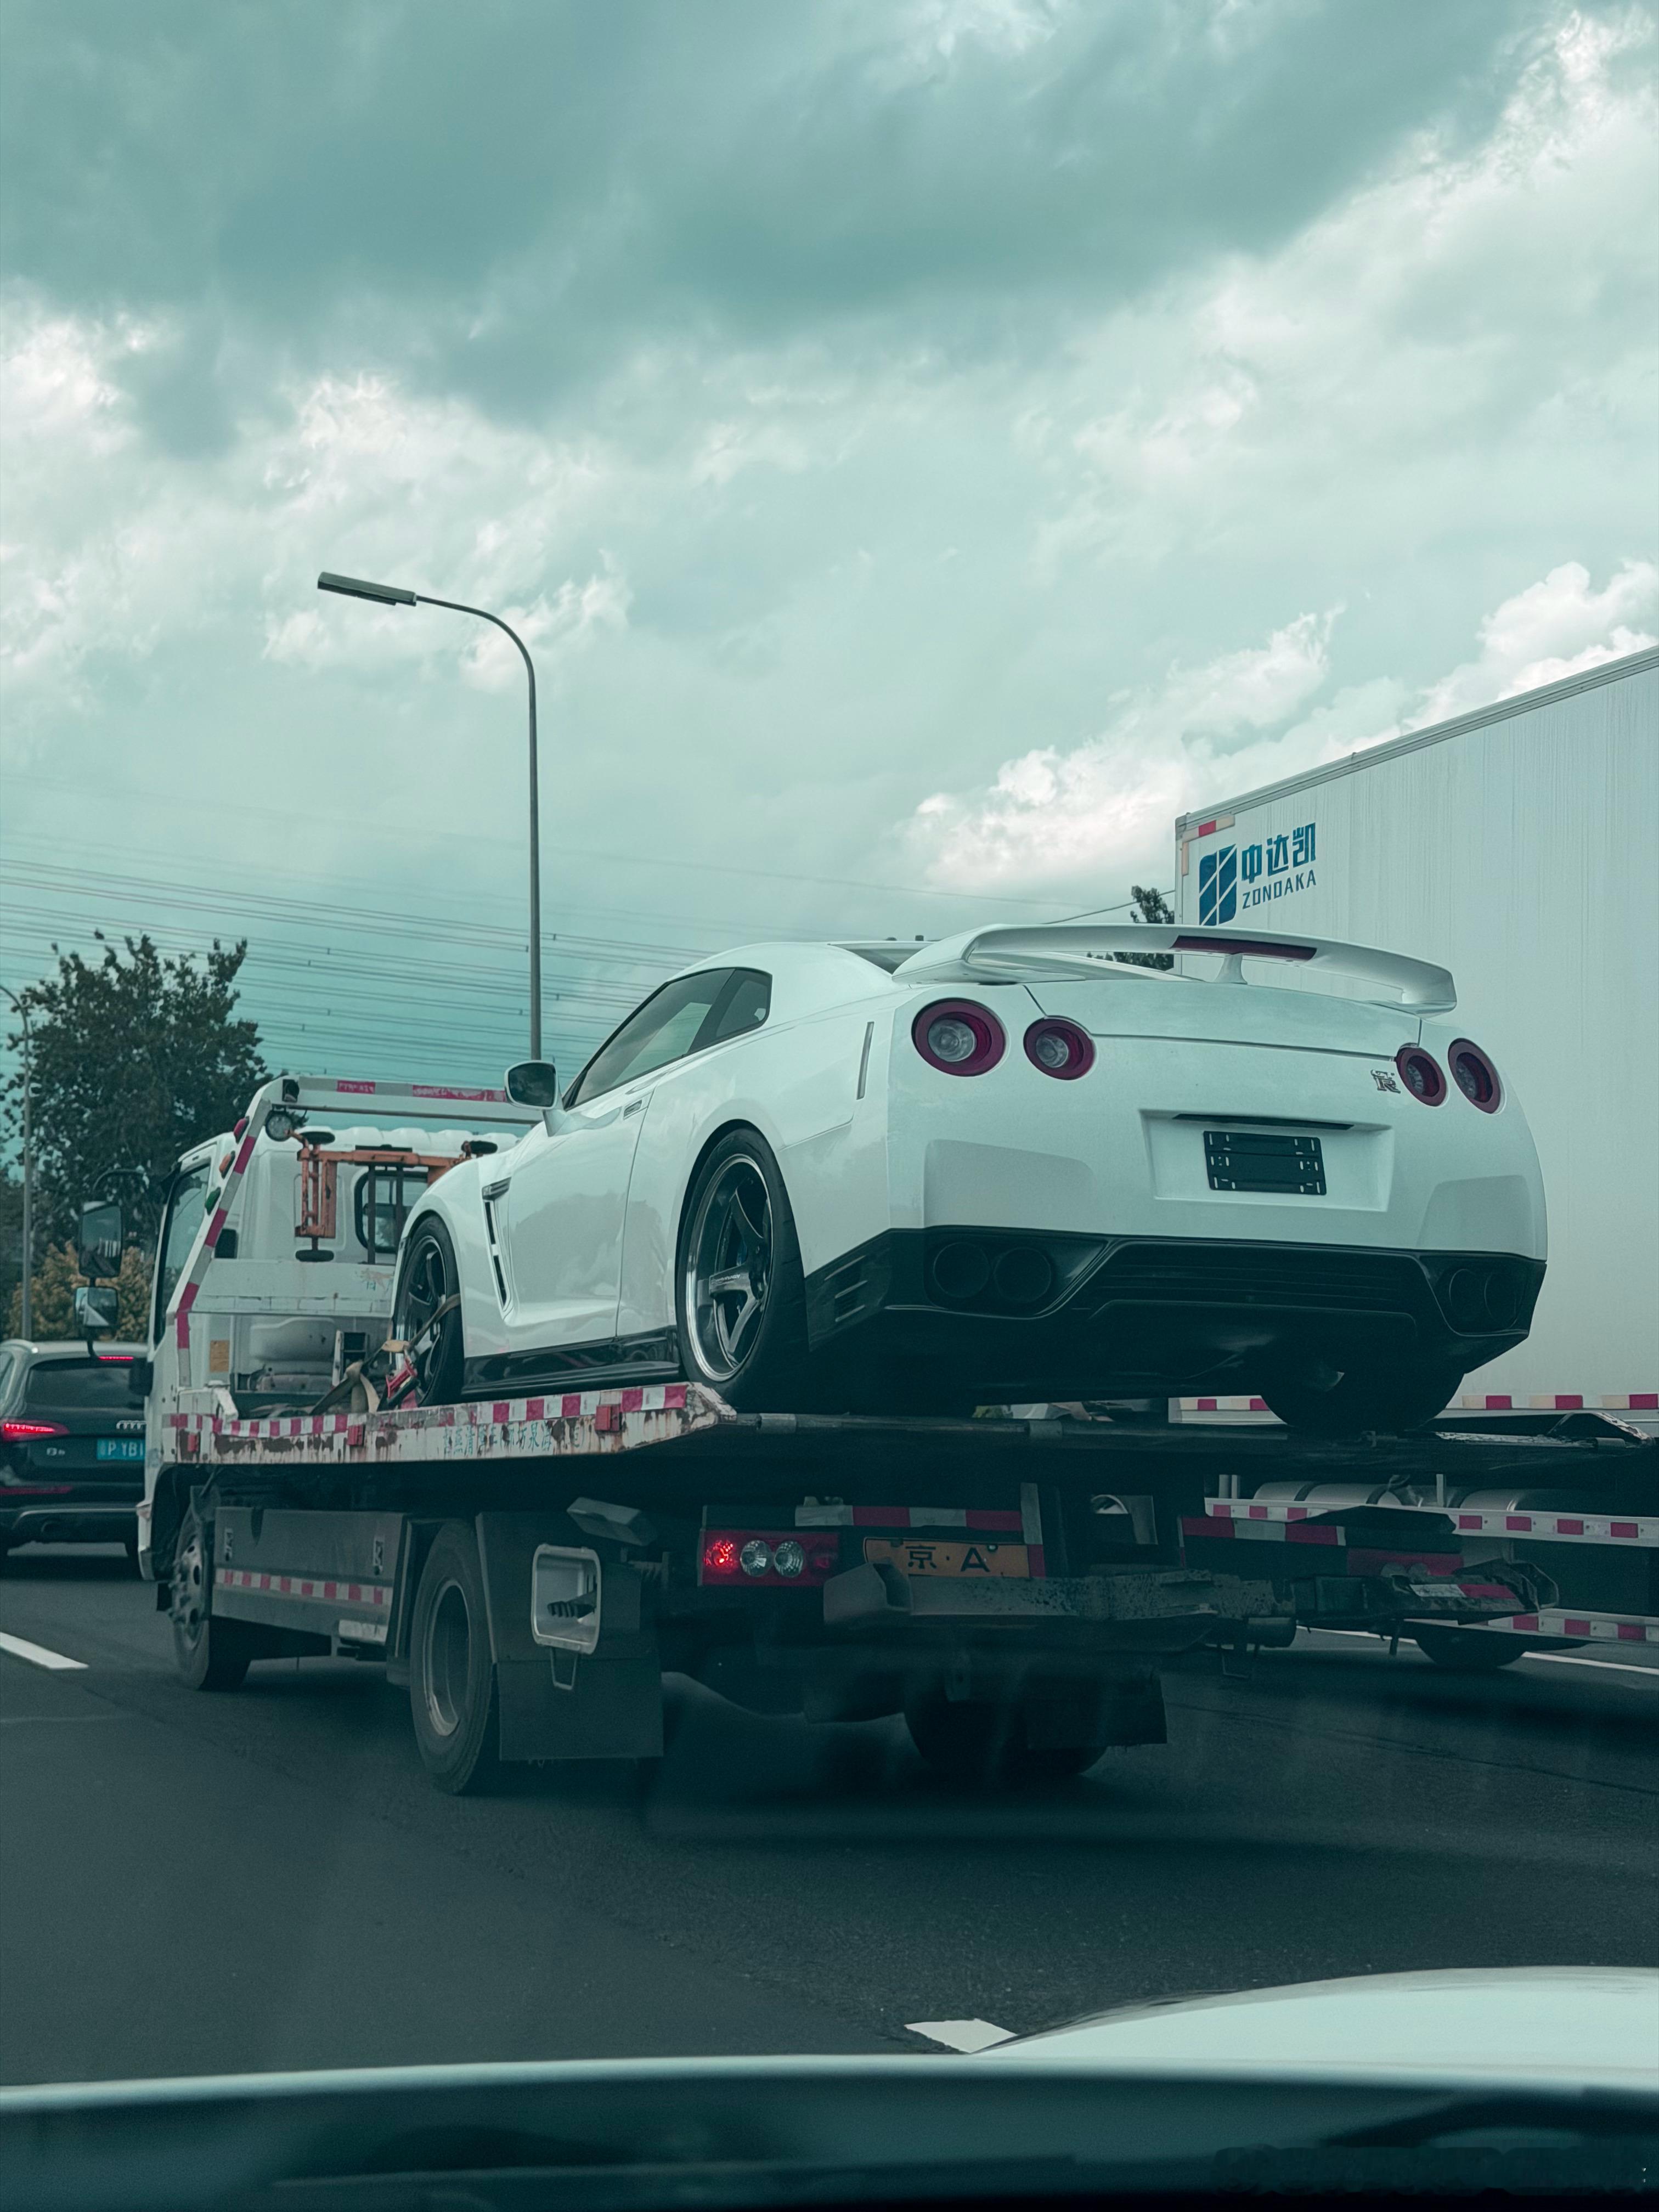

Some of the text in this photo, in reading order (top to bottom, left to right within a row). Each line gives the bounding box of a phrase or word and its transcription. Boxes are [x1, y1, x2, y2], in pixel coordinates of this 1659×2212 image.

[1242, 822, 1316, 884] 中达凯
[1242, 869, 1317, 910] ZONDAKA
